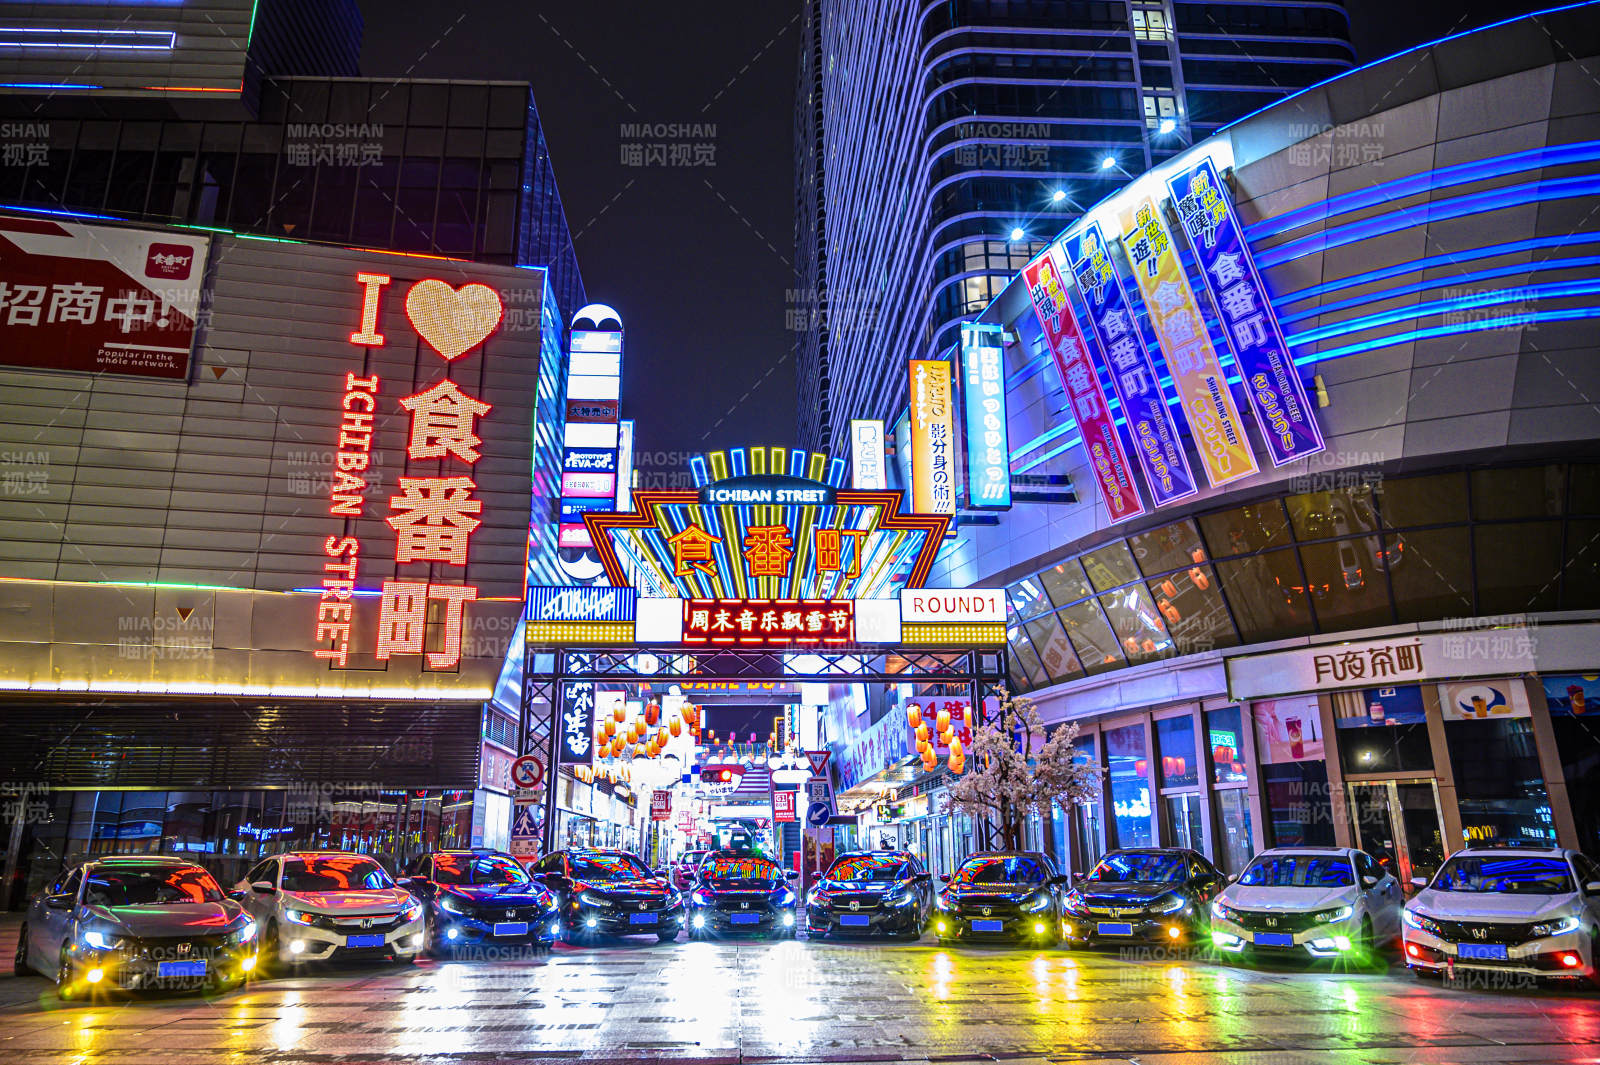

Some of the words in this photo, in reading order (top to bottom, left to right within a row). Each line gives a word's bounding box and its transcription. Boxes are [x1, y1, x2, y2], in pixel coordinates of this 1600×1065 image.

[1191, 170, 1228, 225] 新世界
[1136, 203, 1169, 256] 新世界
[149, 252, 191, 267] 食番町
[1082, 233, 1114, 285] 新世界
[0, 281, 170, 334] 招商中!
[350, 272, 391, 346] I
[1207, 251, 1269, 352] 食番町
[96, 357, 129, 366] whole
[130, 359, 179, 370] network.
[97, 349, 140, 360] Popular
[142, 351, 153, 360] in
[155, 352, 174, 362] the
[1055, 334, 1100, 423] 食番町
[1098, 307, 1150, 399] 食番町
[1221, 419, 1238, 446] STREET
[1284, 394, 1302, 423] STREET
[330, 372, 379, 516] ICHIBAN
[709, 489, 772, 502] ICHIBAN
[775, 489, 827, 502] STREET
[375, 378, 494, 669] 食番町
[667, 523, 869, 579] 食番町
[313, 534, 359, 668] STREET
[690, 609, 849, 632] 周末音乐飘雪节
[913, 596, 996, 614] ROUND1
